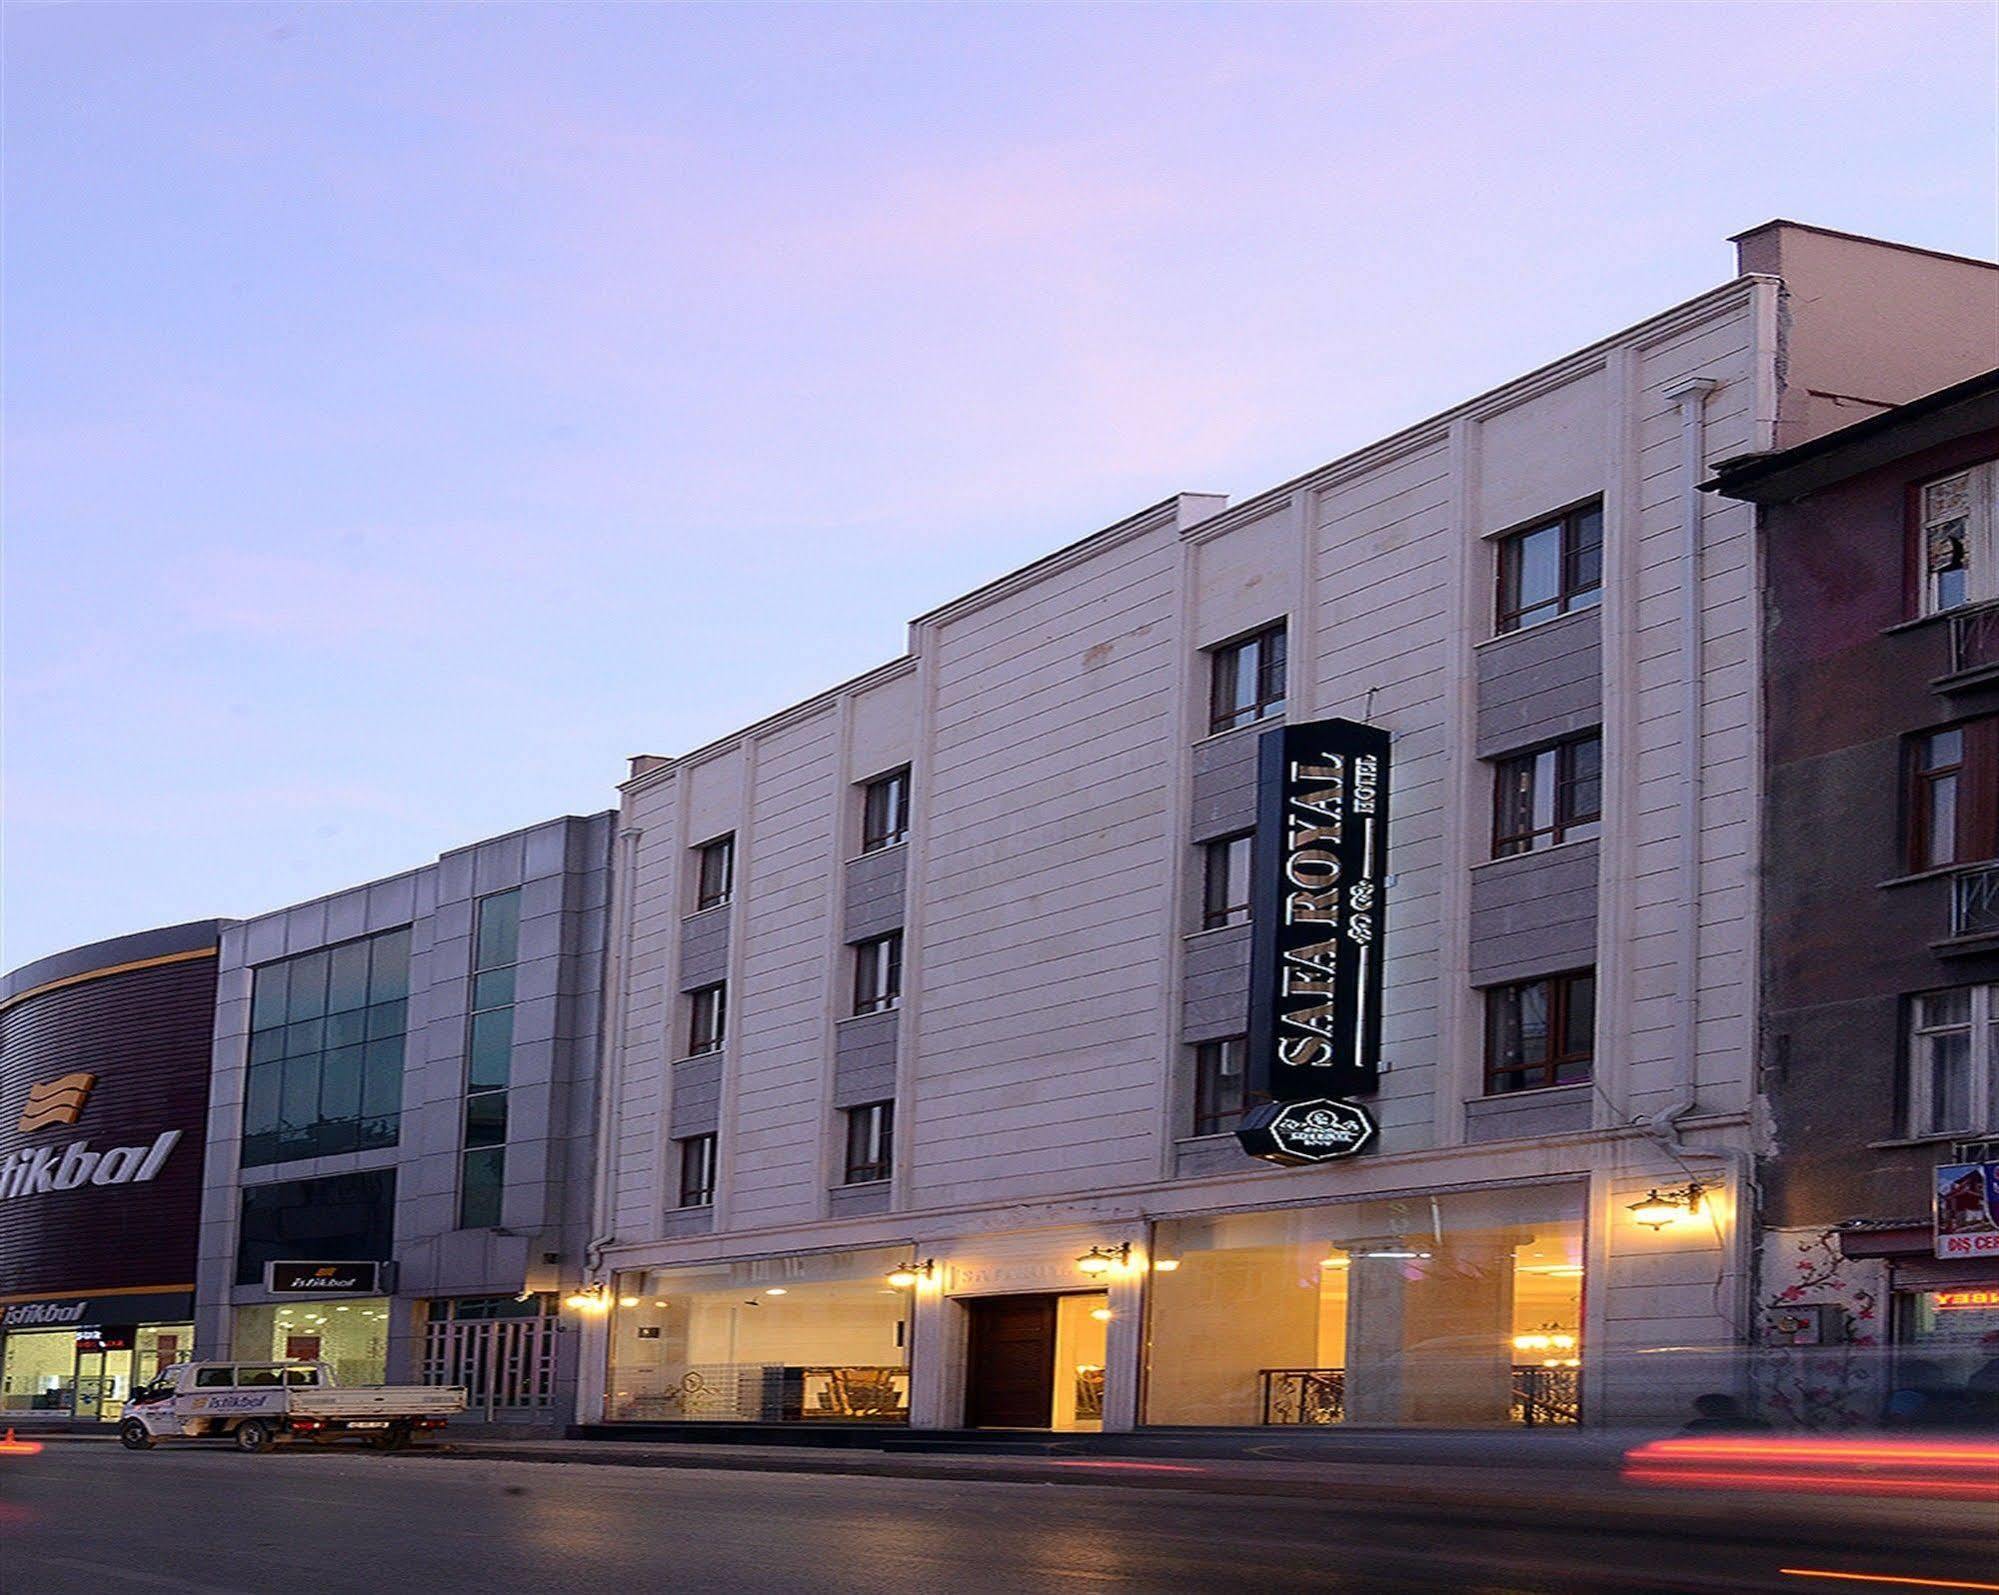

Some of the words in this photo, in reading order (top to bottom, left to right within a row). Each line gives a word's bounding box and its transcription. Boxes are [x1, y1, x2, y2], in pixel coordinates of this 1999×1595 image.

[1353, 754, 1378, 814] HOTEL
[1285, 751, 1346, 927] ROYAL
[1278, 937, 1337, 1067] SAFA
[2, 1301, 88, 1325] istikbal
